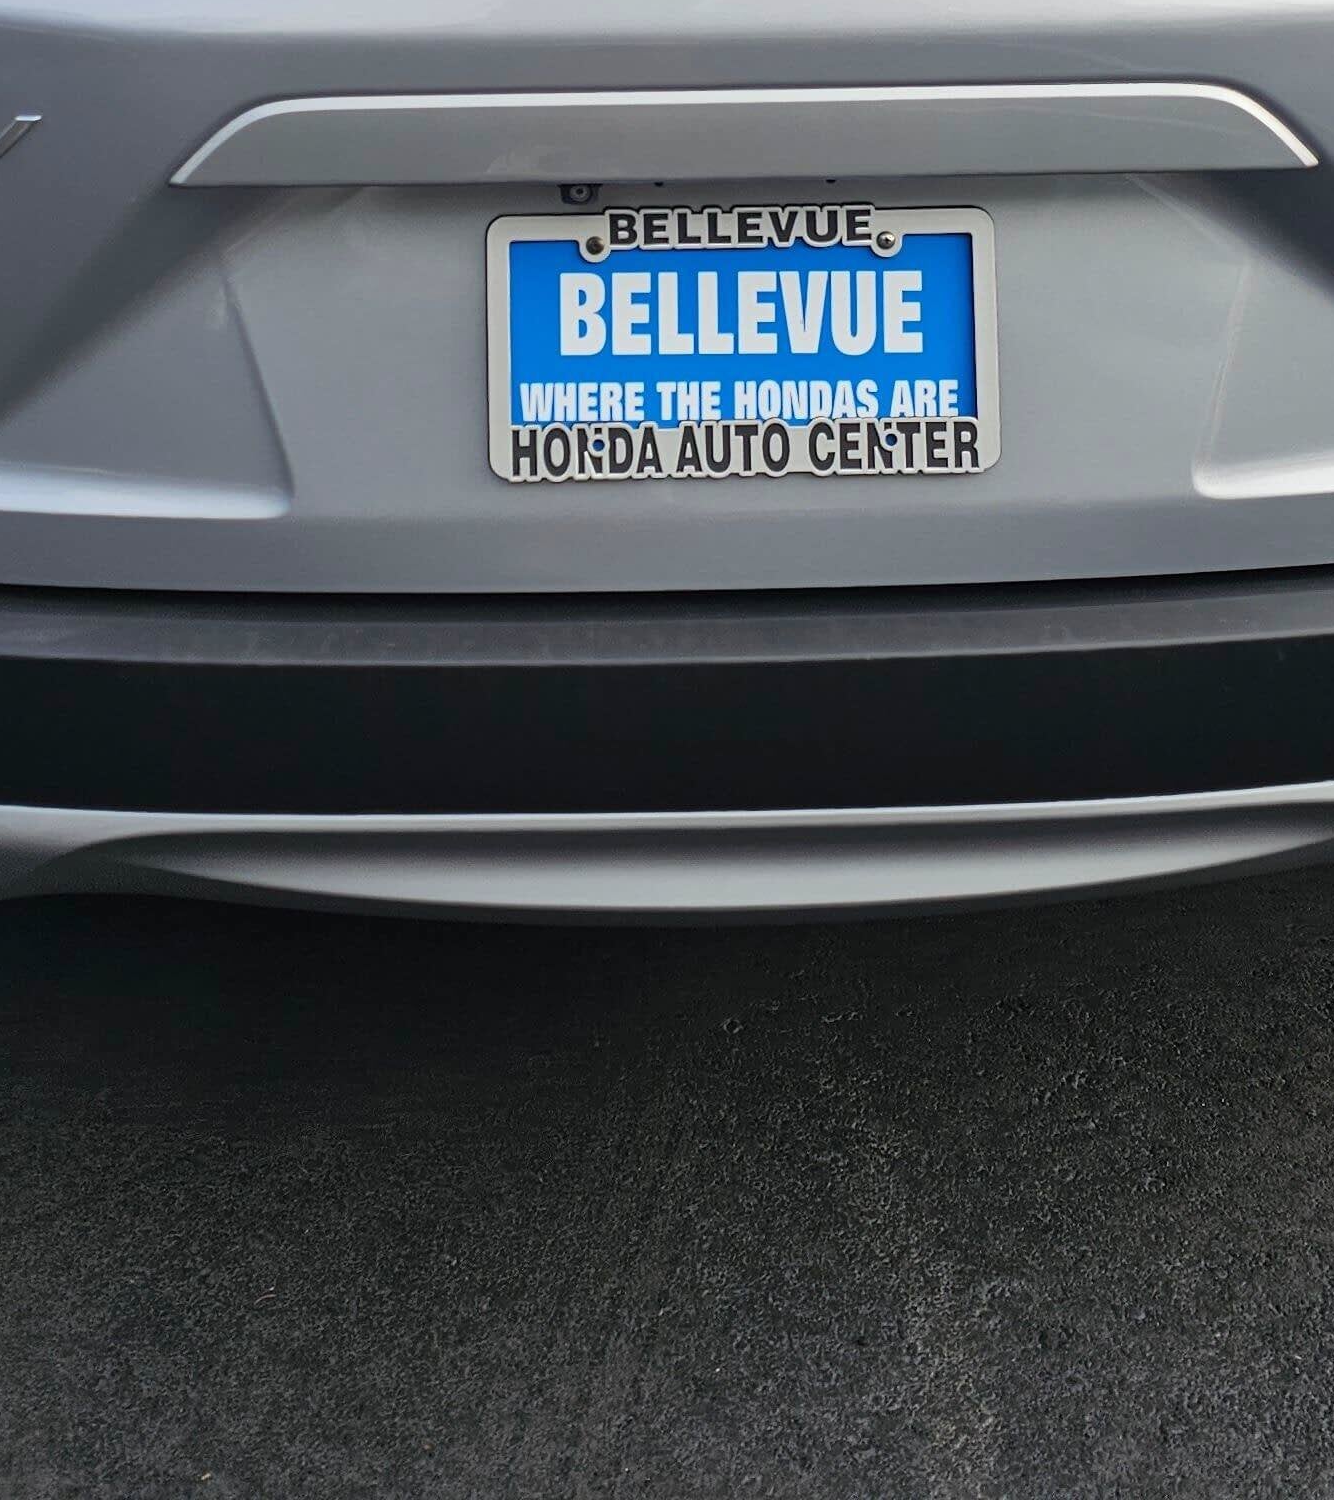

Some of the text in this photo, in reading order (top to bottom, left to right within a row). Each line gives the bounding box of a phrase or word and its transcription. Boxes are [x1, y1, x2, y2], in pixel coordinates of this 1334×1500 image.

[609, 208, 872, 246] BELLEVUE
[559, 269, 924, 356] BELLEVUE
[520, 379, 960, 422] WHERE THE HONDAS ARE
[512, 420, 980, 476] HONDA AUTO CENTER
